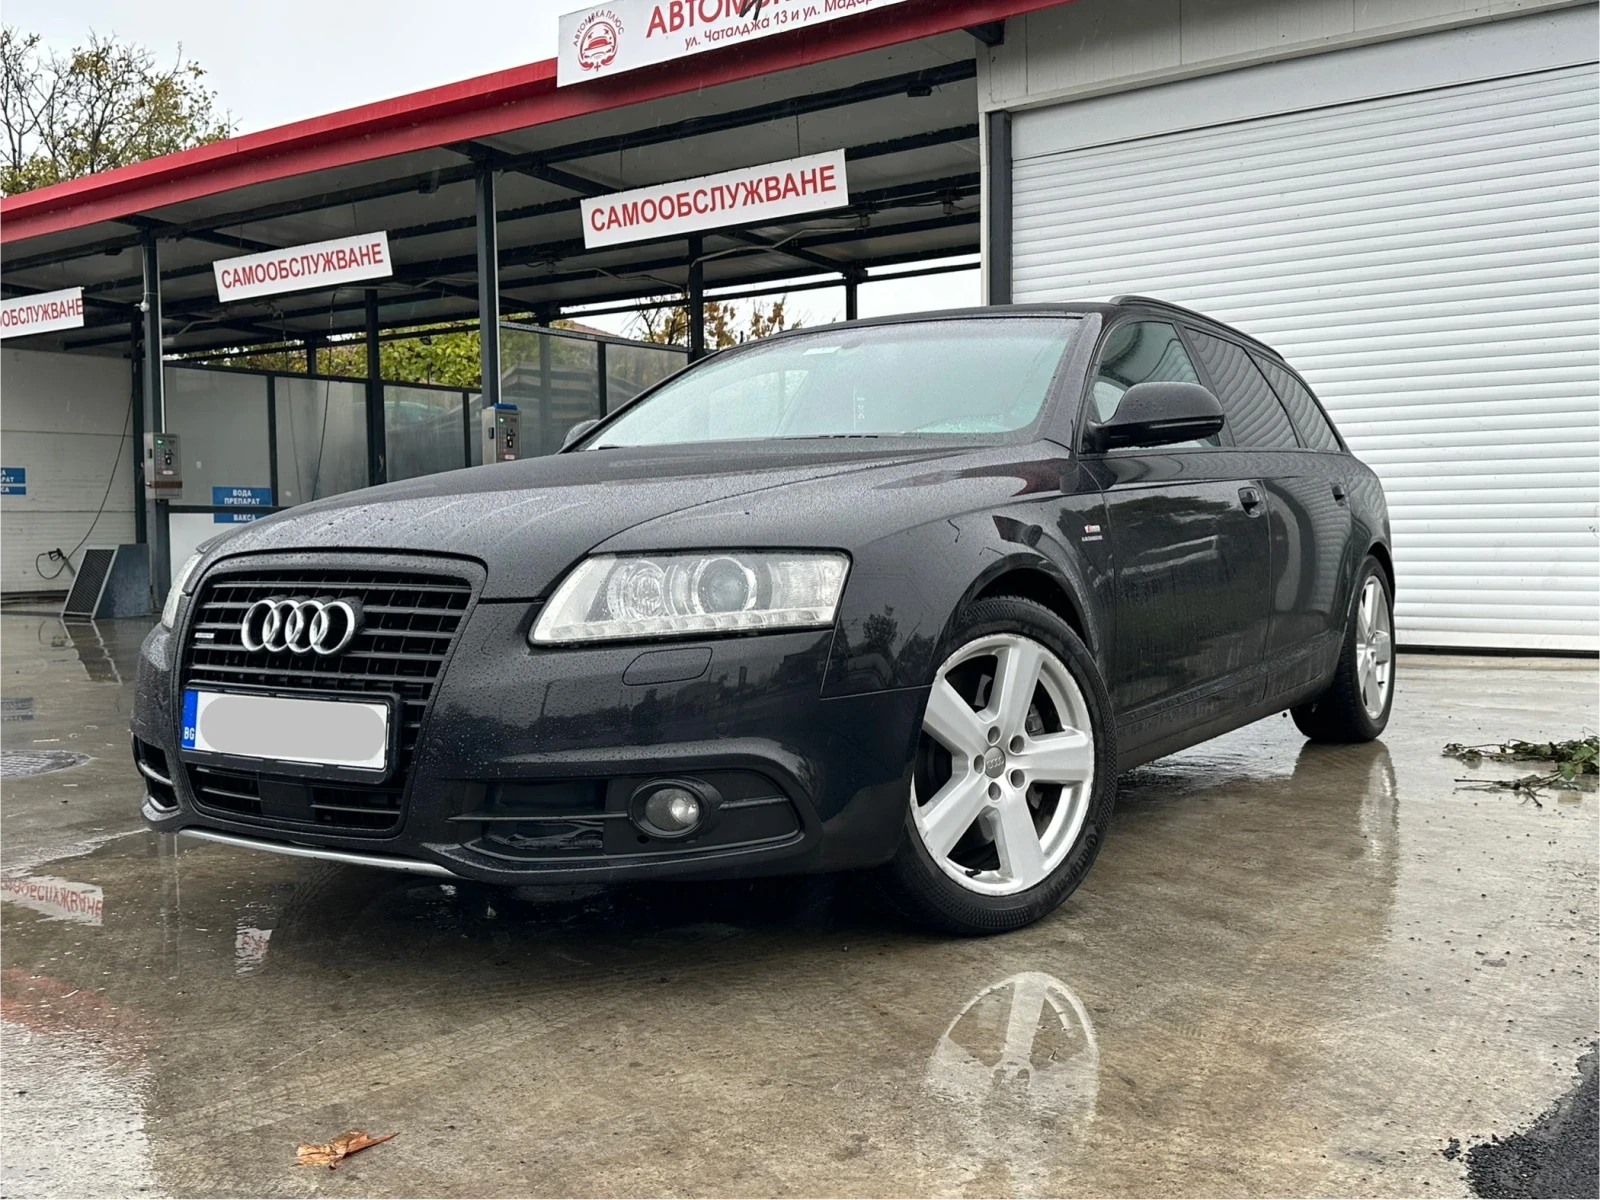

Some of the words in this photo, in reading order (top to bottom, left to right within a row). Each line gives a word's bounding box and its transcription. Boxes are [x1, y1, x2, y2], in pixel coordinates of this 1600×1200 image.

[606, 10, 625, 35] ПЛЮС
[685, 36, 701, 51] ул.
[704, 17, 770, 43] Чаталджа
[773, 10, 788, 25] 13
[791, 9, 800, 22] и
[803, 5, 820, 21] ул.
[591, 164, 837, 232] САМООБСЛУЖВАНЕ
[221, 243, 384, 289] САМООБСЛУЖВАНЕ
[0, 297, 84, 327] ОБСЛУЖВАНЕ
[224, 497, 260, 505] ПРЕПАРАТ
[232, 489, 252, 498] ВОДА
[233, 513, 256, 521] ВАКСА
[184, 727, 195, 740] BG
